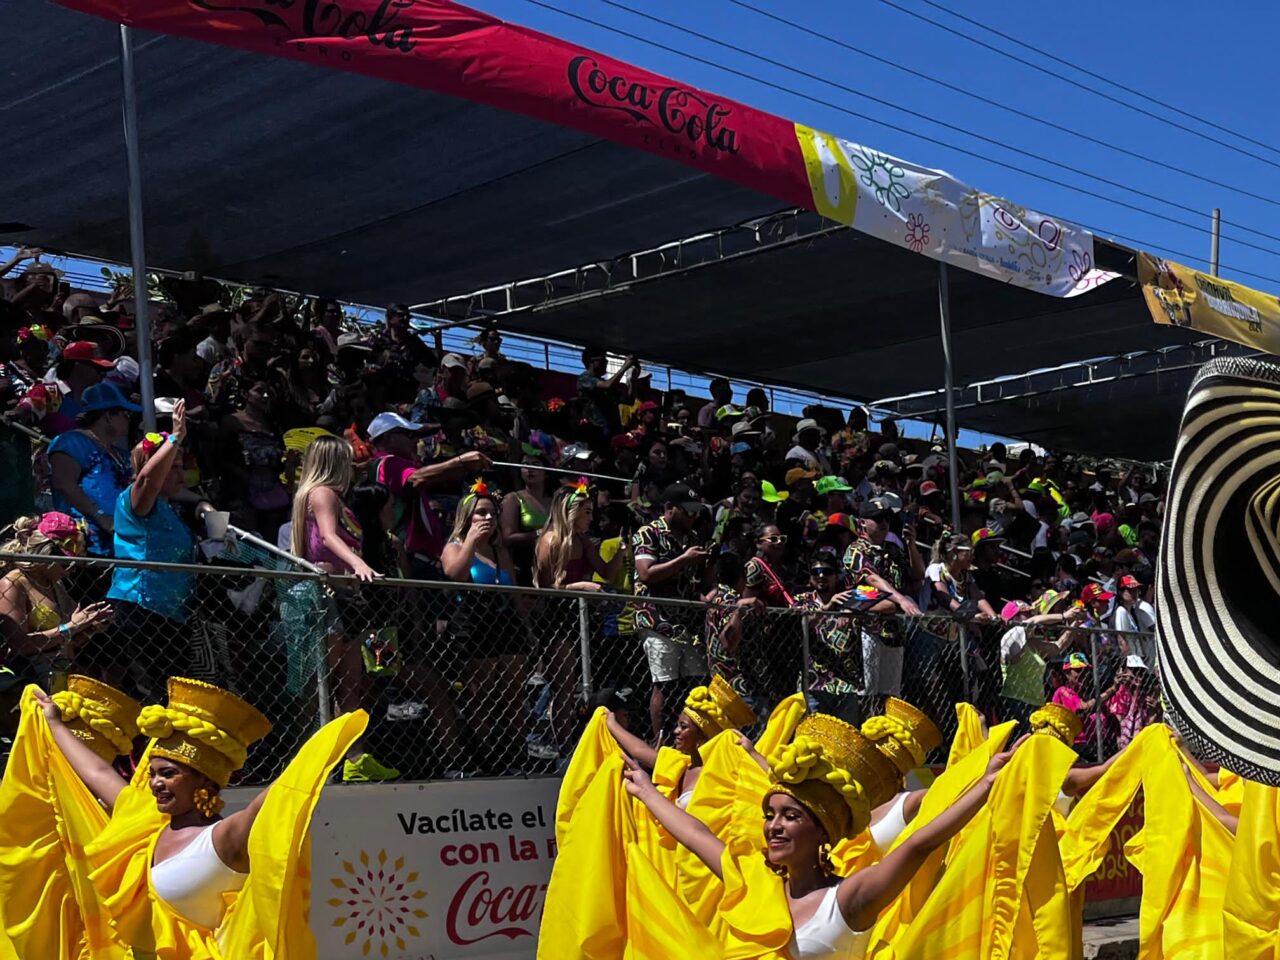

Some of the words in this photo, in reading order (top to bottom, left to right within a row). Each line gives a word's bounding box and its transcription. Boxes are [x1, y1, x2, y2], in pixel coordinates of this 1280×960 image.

[567, 55, 741, 155] Coca-Cola
[397, 808, 513, 835] Vacílate
[521, 805, 546, 828] el
[440, 842, 500, 866] con
[509, 835, 538, 861] la
[1086, 853, 1129, 881] 024
